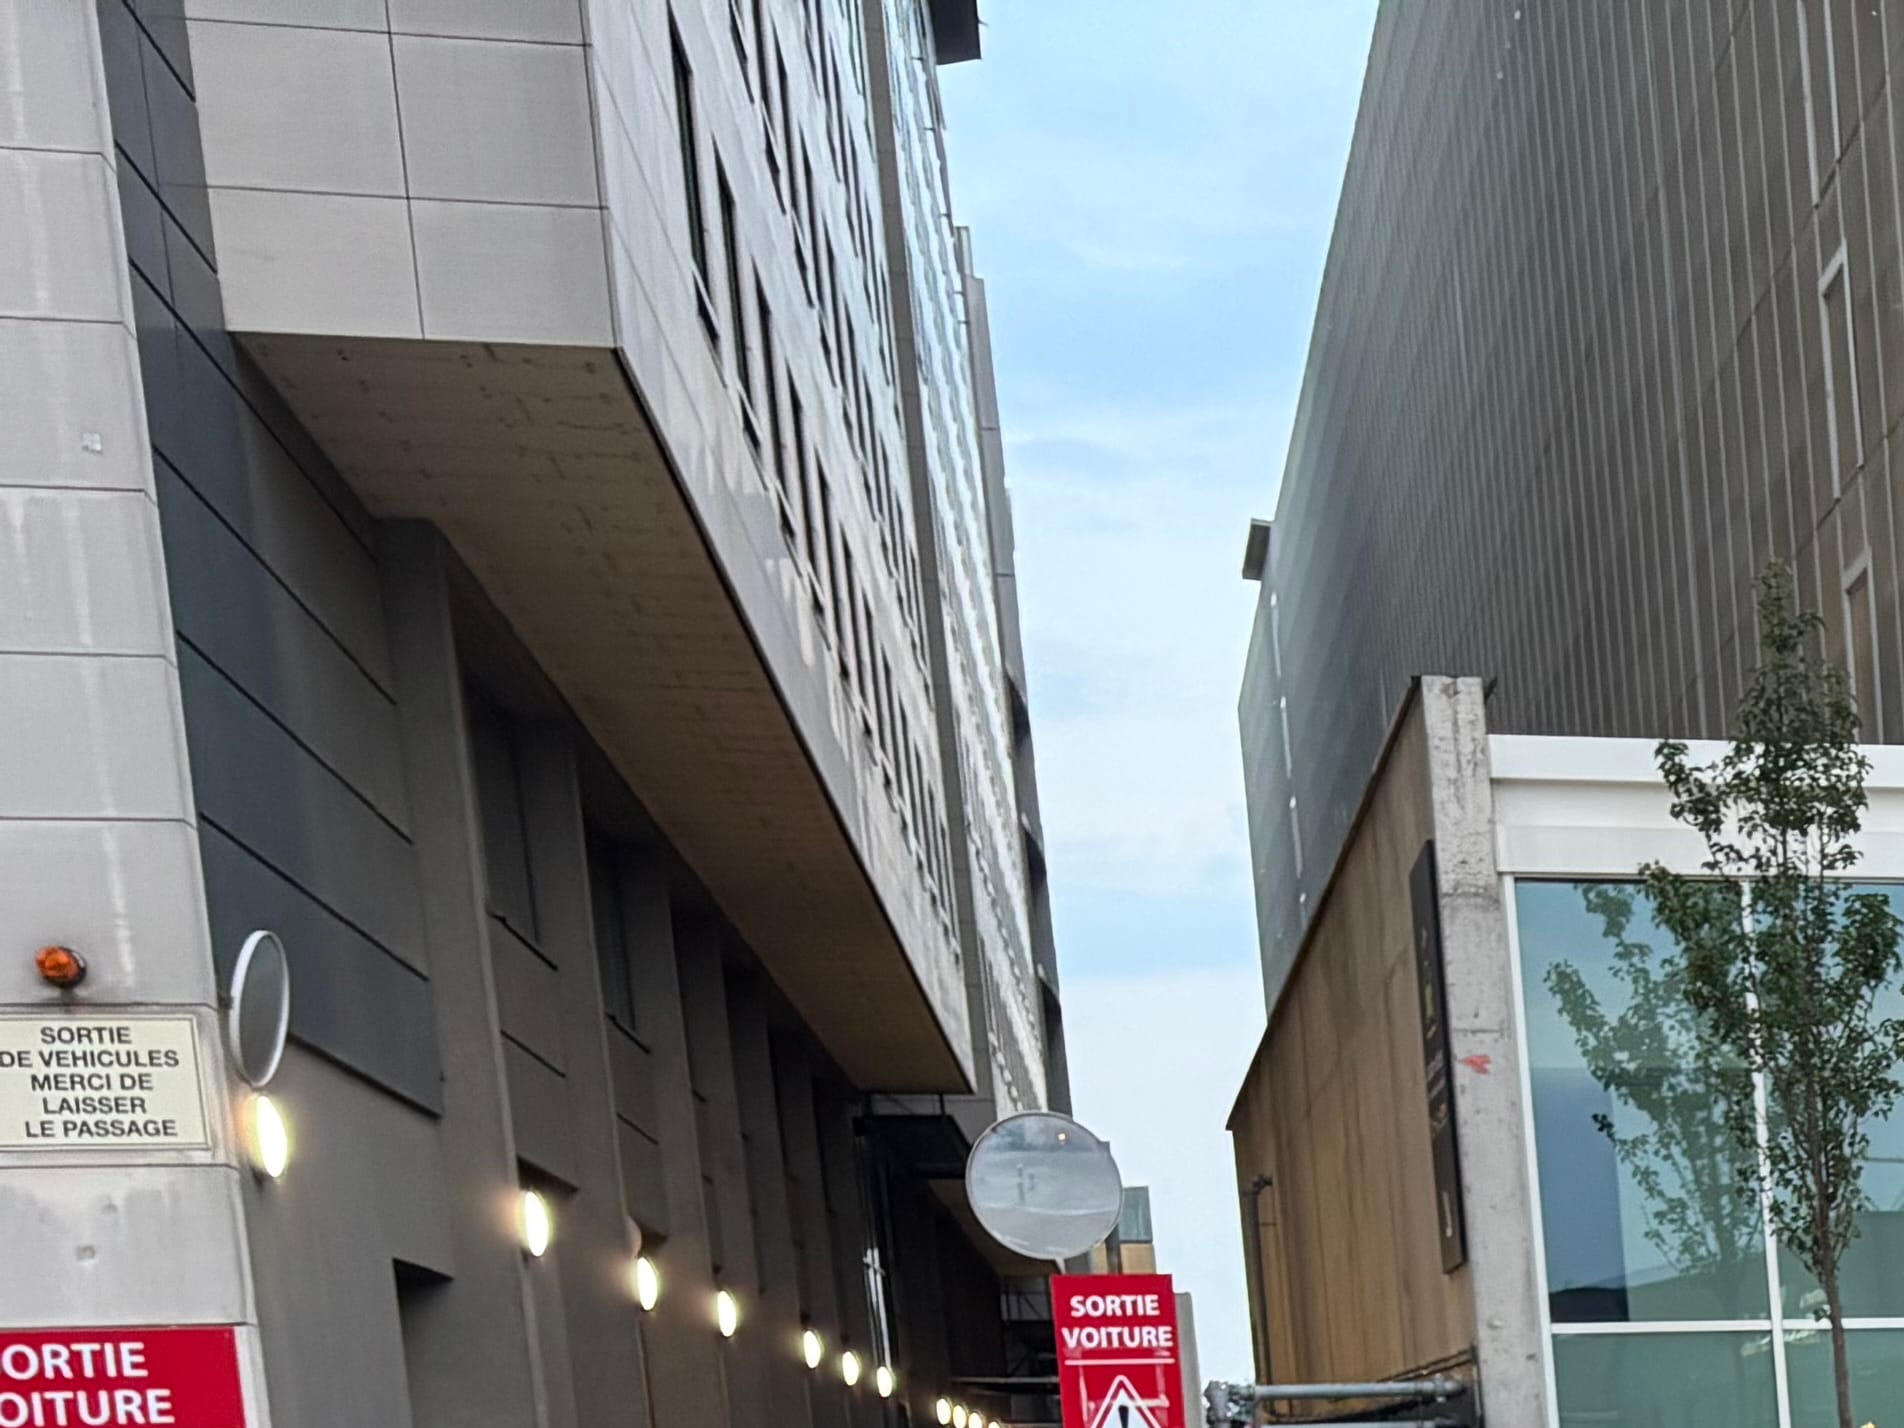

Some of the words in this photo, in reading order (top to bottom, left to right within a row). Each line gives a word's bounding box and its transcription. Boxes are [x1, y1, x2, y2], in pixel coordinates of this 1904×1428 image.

[40, 1026, 133, 1044] SORTIE
[0, 1051, 33, 1068] DE
[39, 1050, 180, 1067] VEHICULES
[31, 1073, 111, 1091] MERCI
[120, 1073, 154, 1090] DE
[42, 1097, 147, 1114] LAISSER
[25, 1121, 55, 1138] LE
[63, 1119, 178, 1137] PASSAGE
[1070, 1294, 1160, 1317] SORTIE
[1061, 1326, 1173, 1349] VOITURE
[0, 1342, 148, 1380] ORTIE
[0, 1388, 175, 1428] OITURE
